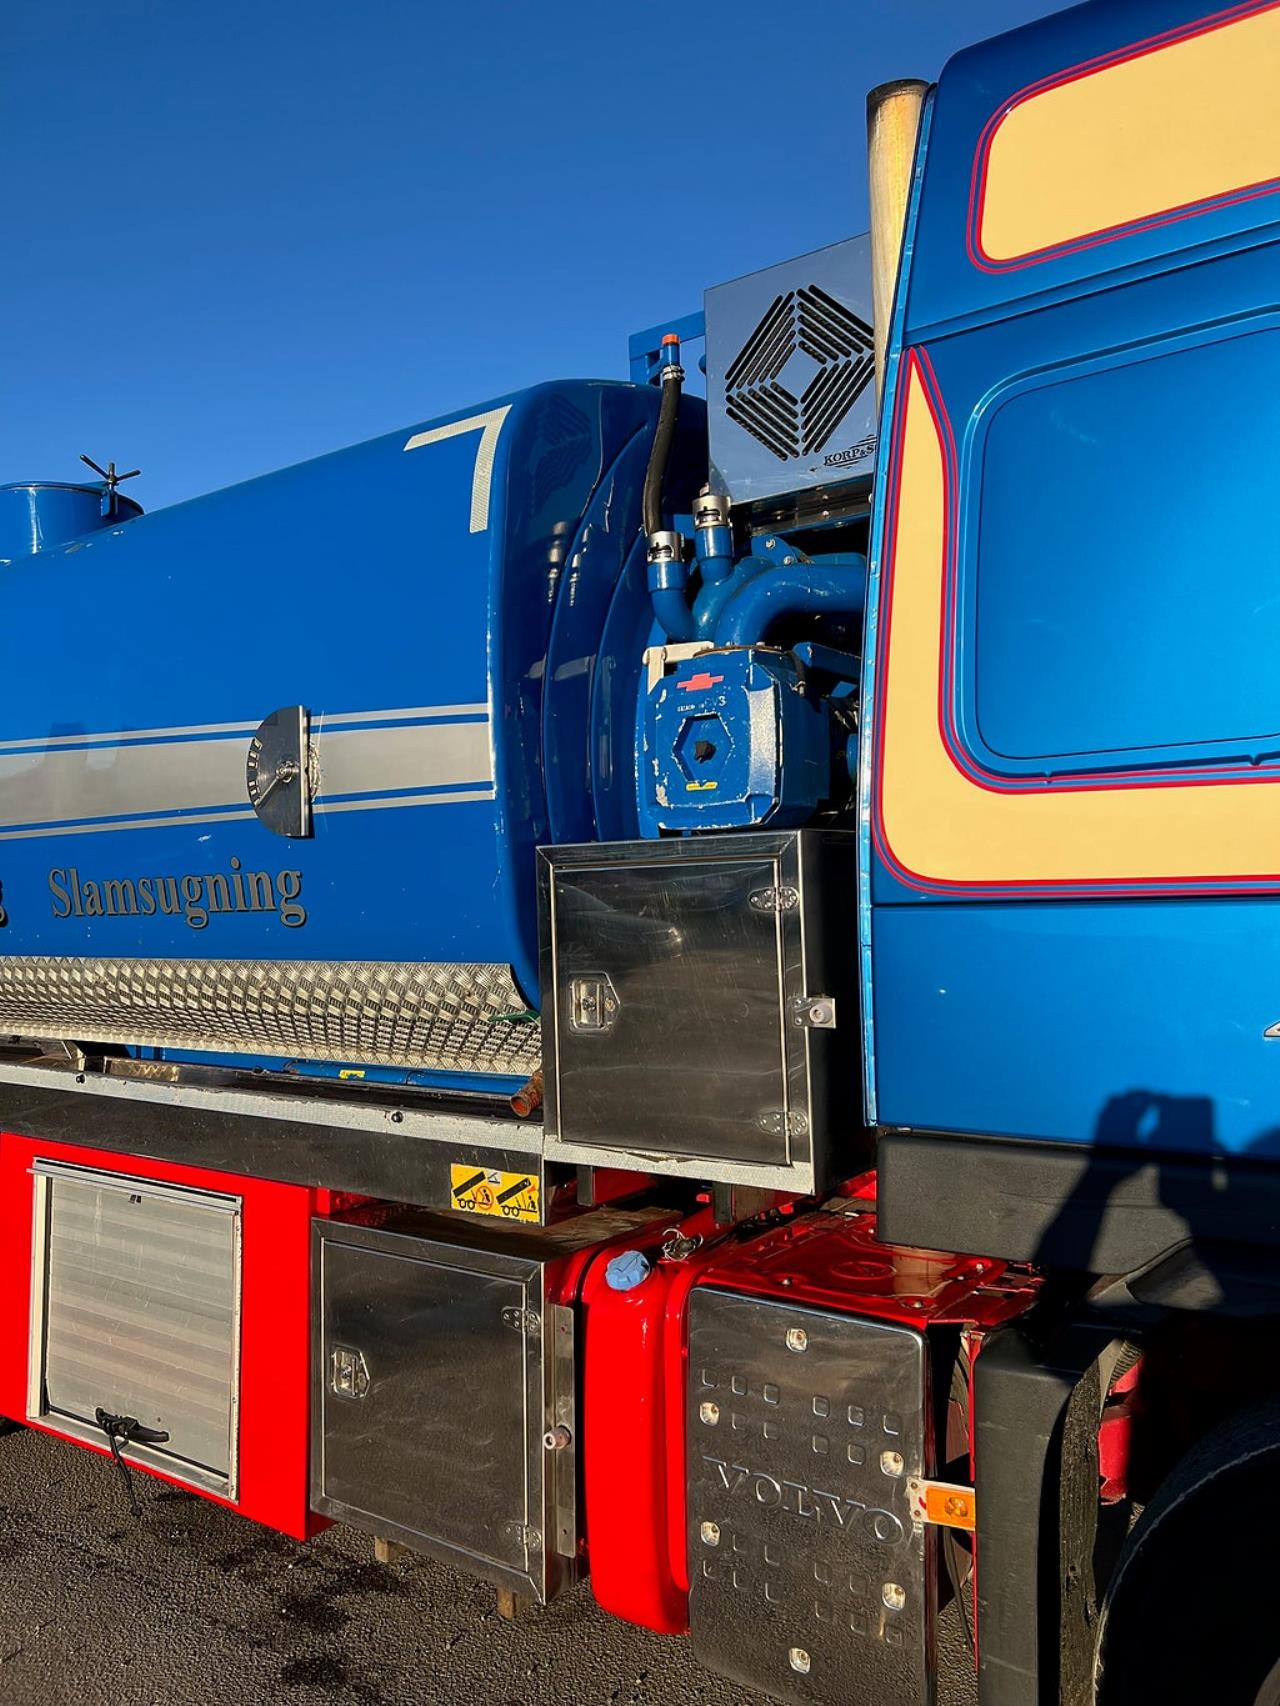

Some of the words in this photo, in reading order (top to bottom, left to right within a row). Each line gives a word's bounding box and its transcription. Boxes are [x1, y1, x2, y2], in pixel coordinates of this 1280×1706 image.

[824, 444, 877, 465] KORP&S
[49, 856, 307, 928] Slamsugning
[702, 1455, 905, 1546] VOLVO
